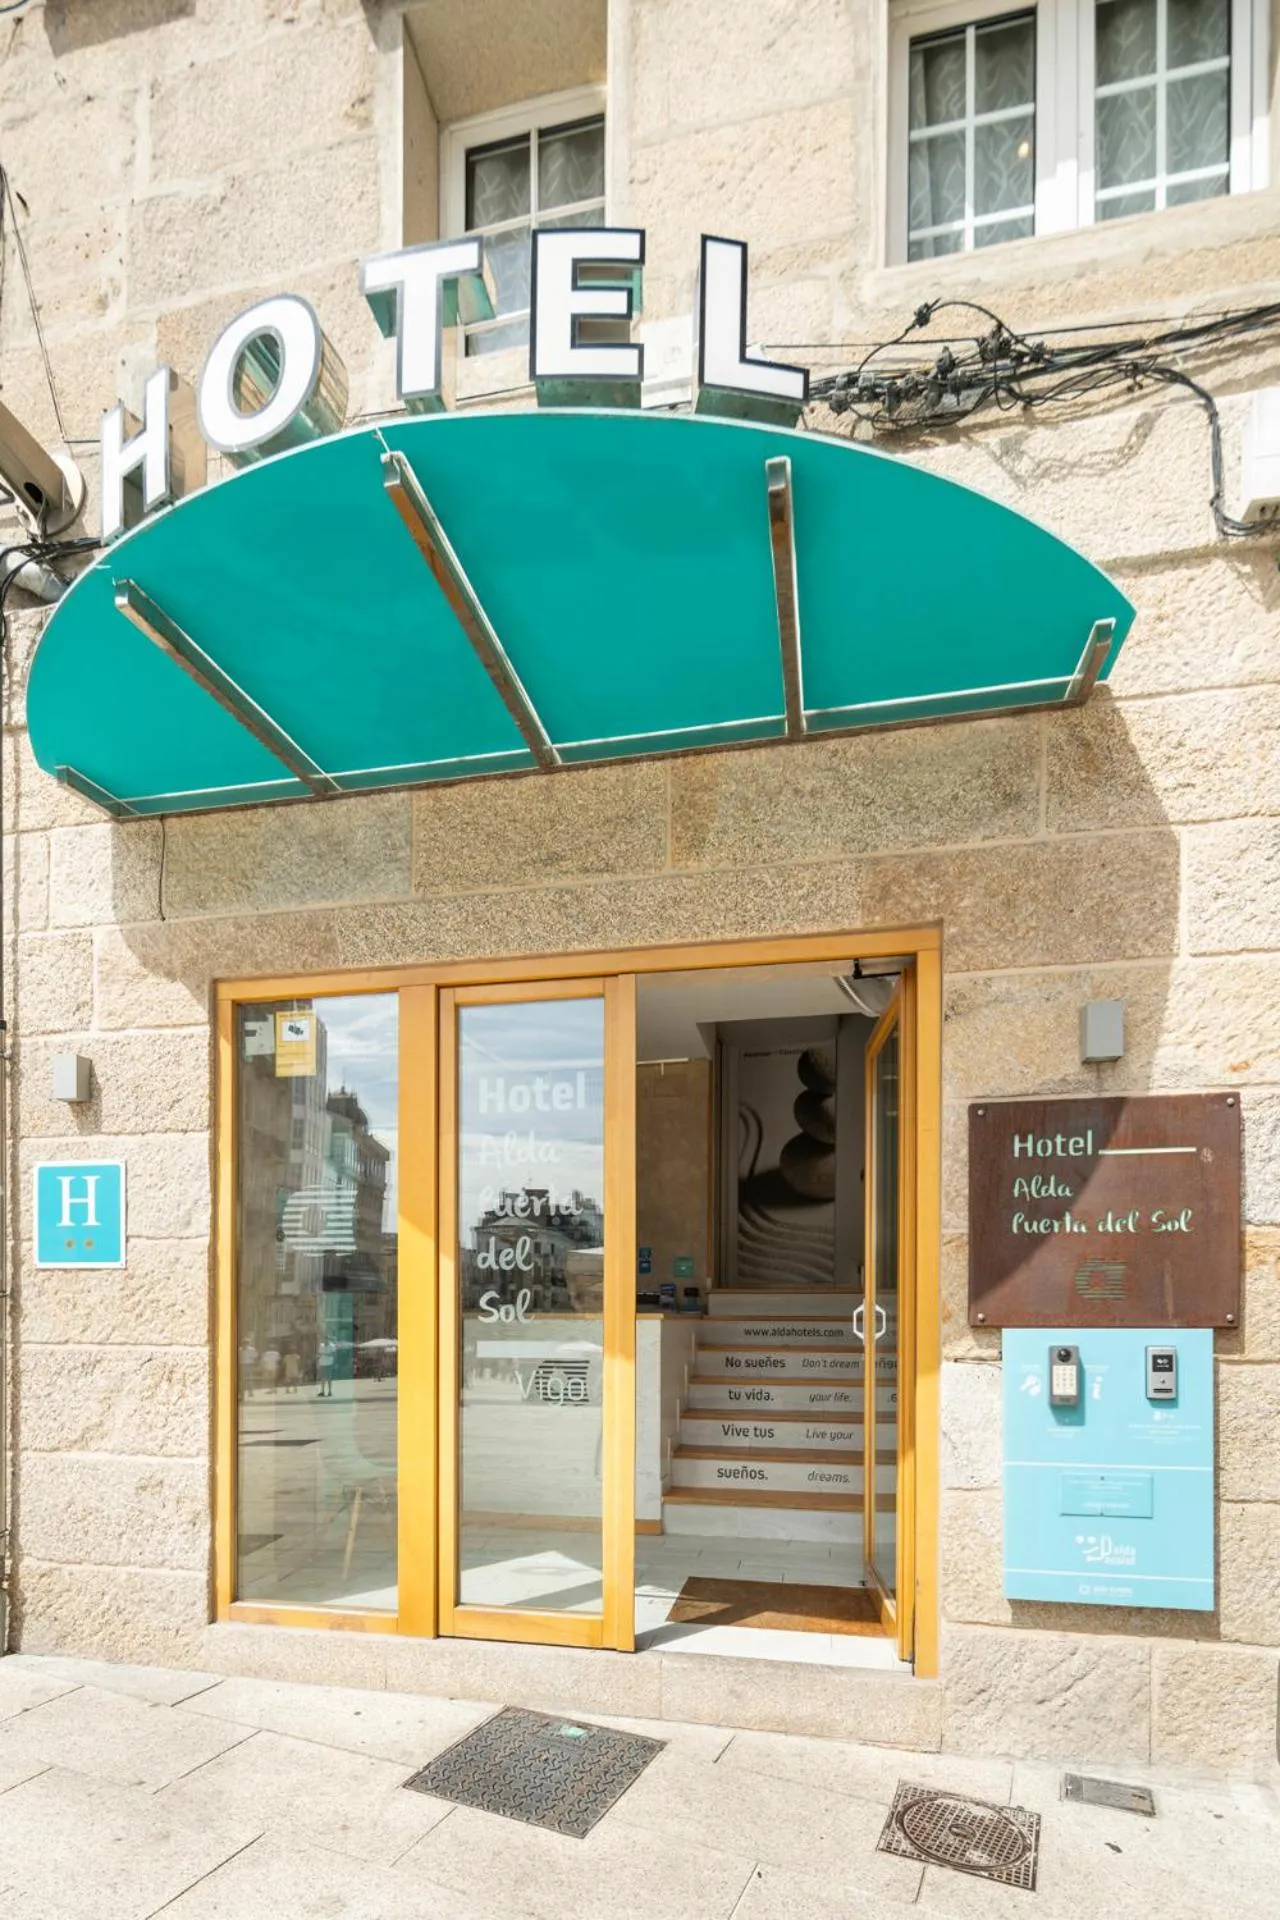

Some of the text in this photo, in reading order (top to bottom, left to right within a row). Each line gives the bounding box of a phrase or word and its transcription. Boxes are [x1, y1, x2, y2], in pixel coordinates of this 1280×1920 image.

[100, 227, 809, 545] HOTEL
[478, 1070, 586, 1115] Hotel
[478, 1128, 563, 1171] Alda
[1013, 1130, 1093, 1158] Hotel
[1013, 1174, 1074, 1201] Alda
[56, 1175, 101, 1227] H
[1012, 1208, 1193, 1234] Puerta del Sol
[477, 1236, 535, 1272] del
[477, 1288, 536, 1324] Sol
[744, 1327, 844, 1338] www.aldahotels.com
[725, 1356, 786, 1369] No sueñes
[801, 1358, 860, 1369] Don't dream
[514, 1368, 584, 1406] Vigo
[728, 1388, 775, 1401] tu vida.
[808, 1392, 853, 1403] your life.
[722, 1424, 775, 1439] Vive tus
[806, 1429, 854, 1442] Live your
[717, 1466, 769, 1481] sueños.
[807, 1470, 851, 1484] dreams.
